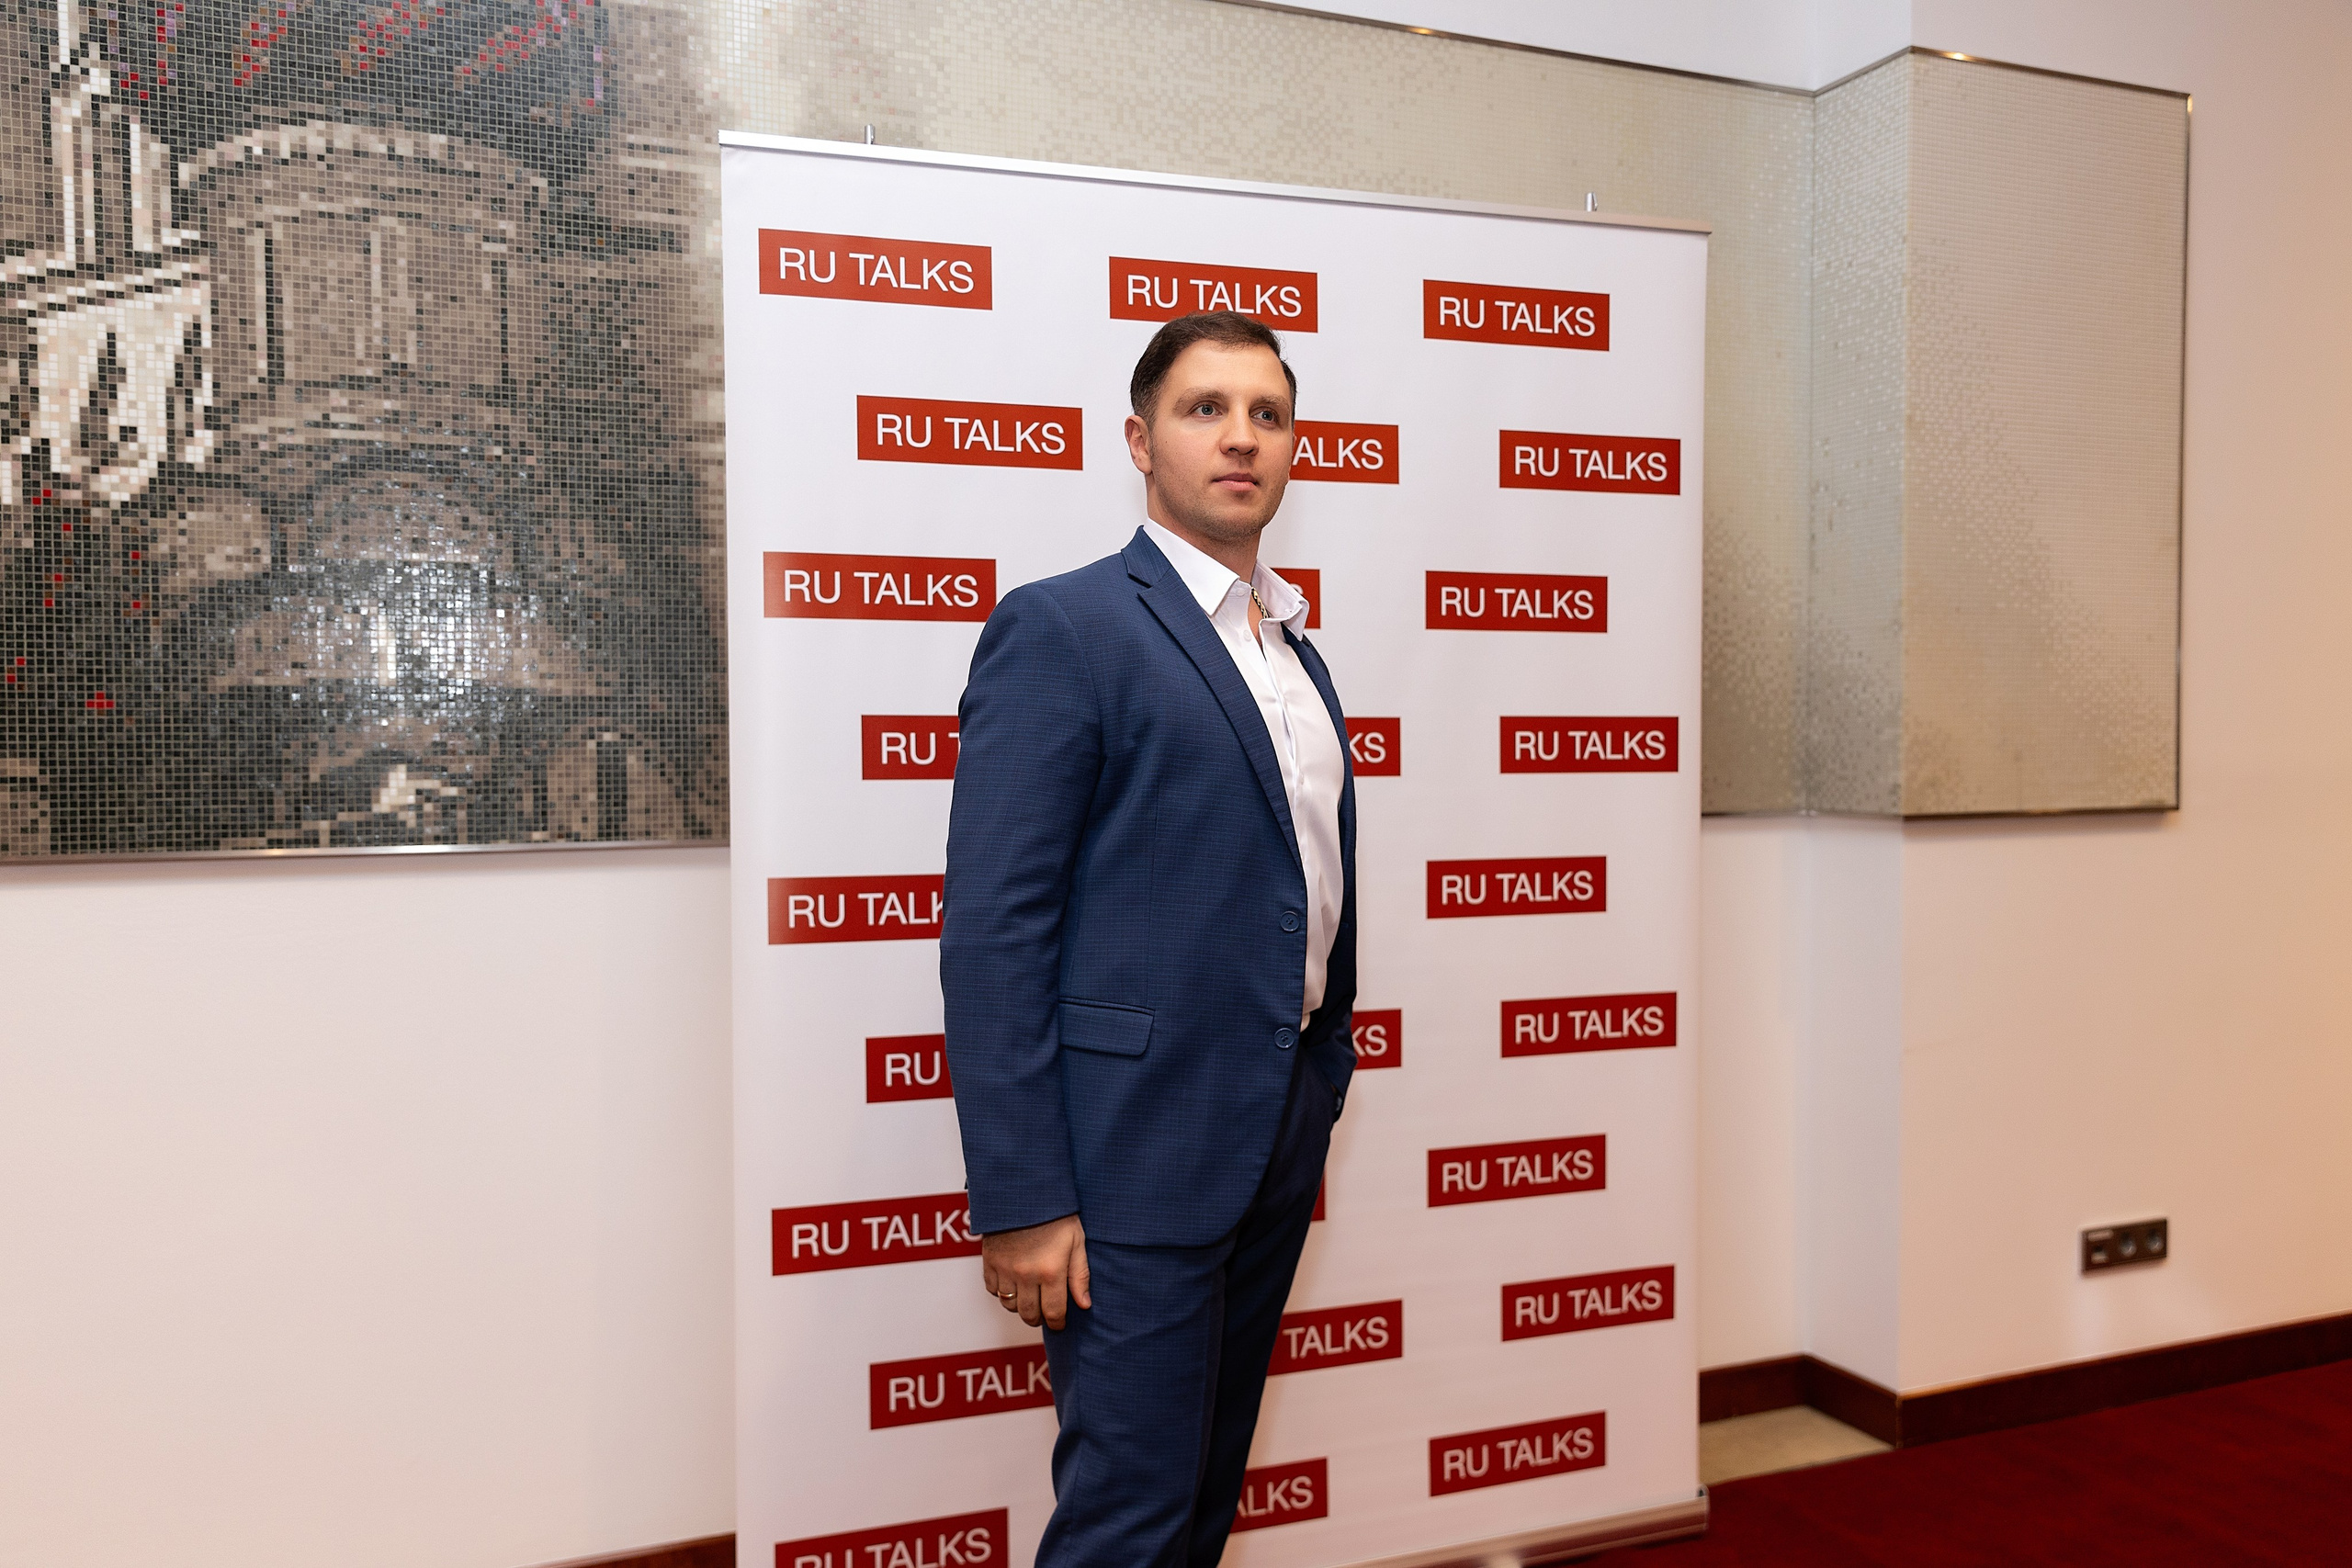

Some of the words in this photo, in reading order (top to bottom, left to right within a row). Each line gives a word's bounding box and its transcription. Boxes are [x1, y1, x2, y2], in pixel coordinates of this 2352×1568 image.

[780, 248, 835, 282] RU
[849, 254, 974, 294] TALKS
[1128, 275, 1178, 309] RU
[1189, 279, 1302, 318] TALKS
[1440, 297, 1485, 329] RU
[1494, 300, 1596, 337] TALKS
[877, 414, 931, 447] RU
[944, 418, 1066, 455] TALKS
[1292, 436, 1384, 470] ALKS
[1516, 446, 1559, 477] RU
[1568, 449, 1668, 482] TALKS
[785, 570, 840, 604] RU
[854, 572, 978, 607] TALKS
[1442, 587, 1486, 617] RU
[1495, 589, 1594, 619] TALKS
[882, 732, 936, 765] RU
[1515, 731, 1559, 761] RU
[1567, 731, 1666, 761] TALKS
[1442, 874, 1487, 905] RU
[1495, 871, 1594, 903] TALKS
[788, 894, 845, 929] RU
[1516, 1013, 1559, 1044] RU
[1567, 1007, 1664, 1040] TALKS
[886, 1052, 941, 1087] RU
[1443, 1160, 1487, 1192] RU
[1496, 1150, 1593, 1186] TALKS
[793, 1221, 850, 1258] RU
[1516, 1293, 1559, 1326] RU
[1567, 1280, 1662, 1318] TALKS
[1283, 1316, 1389, 1359] TALKS
[889, 1373, 944, 1412] RU
[956, 1359, 1052, 1402] TALK
[1444, 1446, 1488, 1480] RU
[1497, 1428, 1593, 1470] TALKS
[1238, 1475, 1314, 1517] LKS
